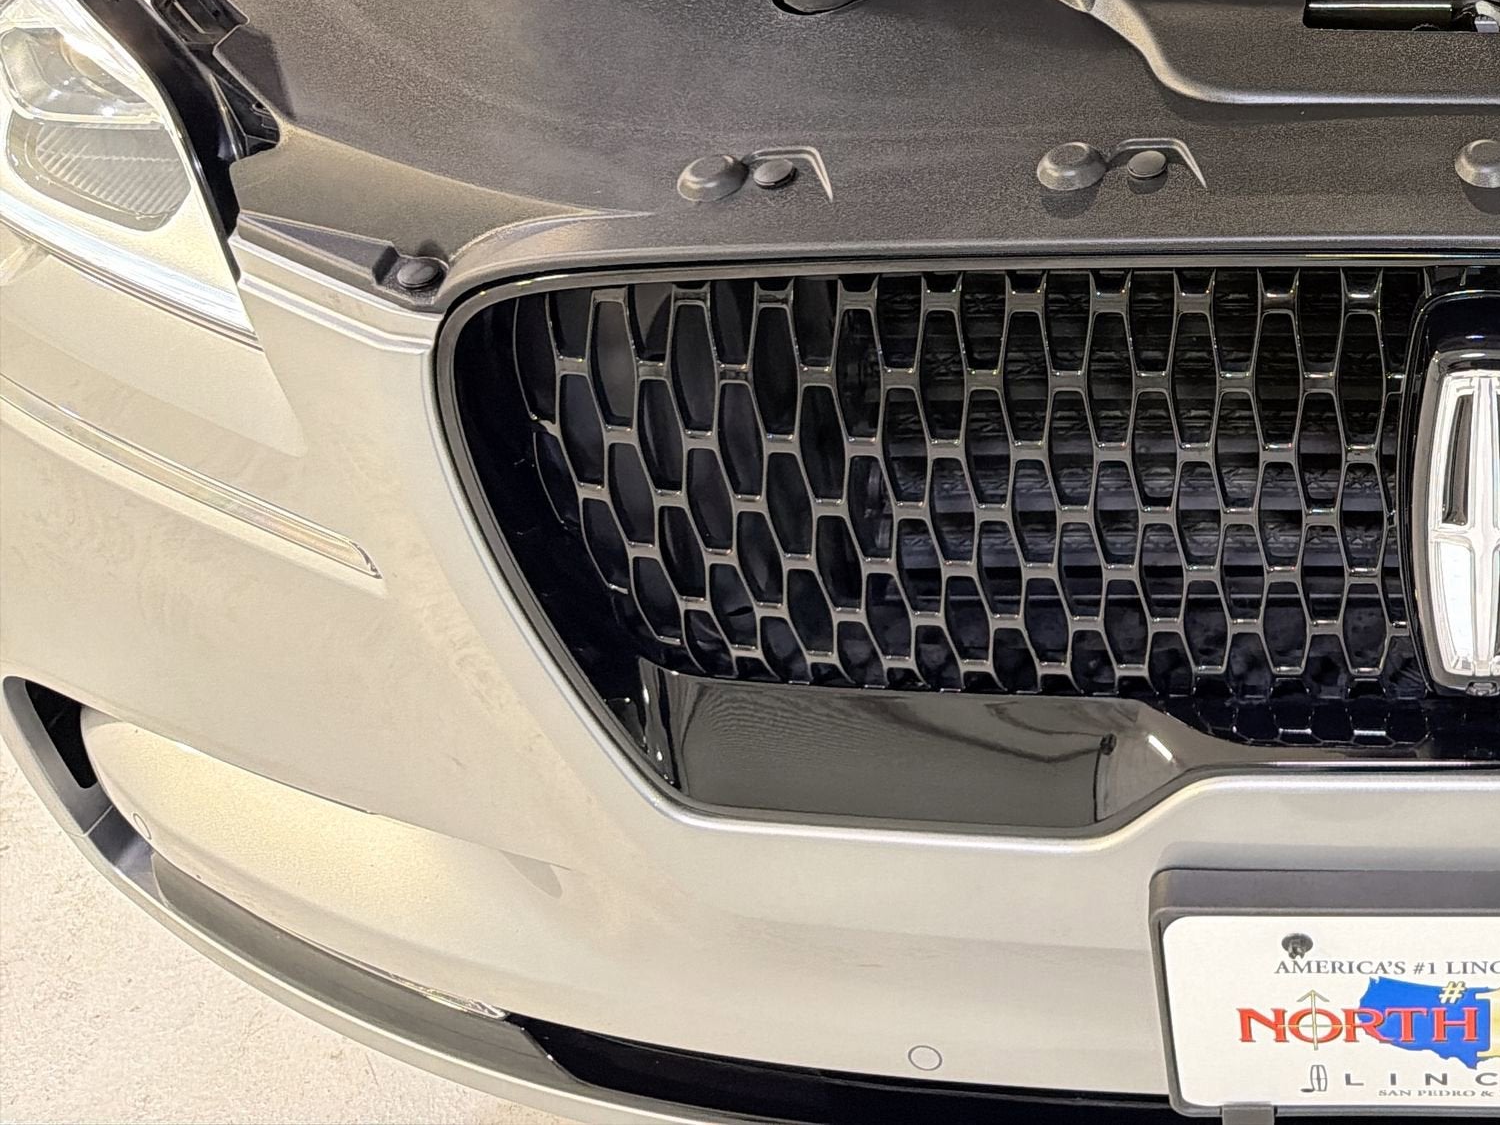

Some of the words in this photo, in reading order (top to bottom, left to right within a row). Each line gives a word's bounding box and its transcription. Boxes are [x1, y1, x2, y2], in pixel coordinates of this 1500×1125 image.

[1274, 960, 1406, 975] AMERICA'S
[1413, 961, 1436, 975] #1
[1439, 981, 1466, 1004] #
[1236, 1007, 1478, 1044] NORTH
[1378, 1089, 1412, 1097] SAN
[1417, 1089, 1476, 1097] PEDRO
[1480, 1090, 1494, 1098] &
